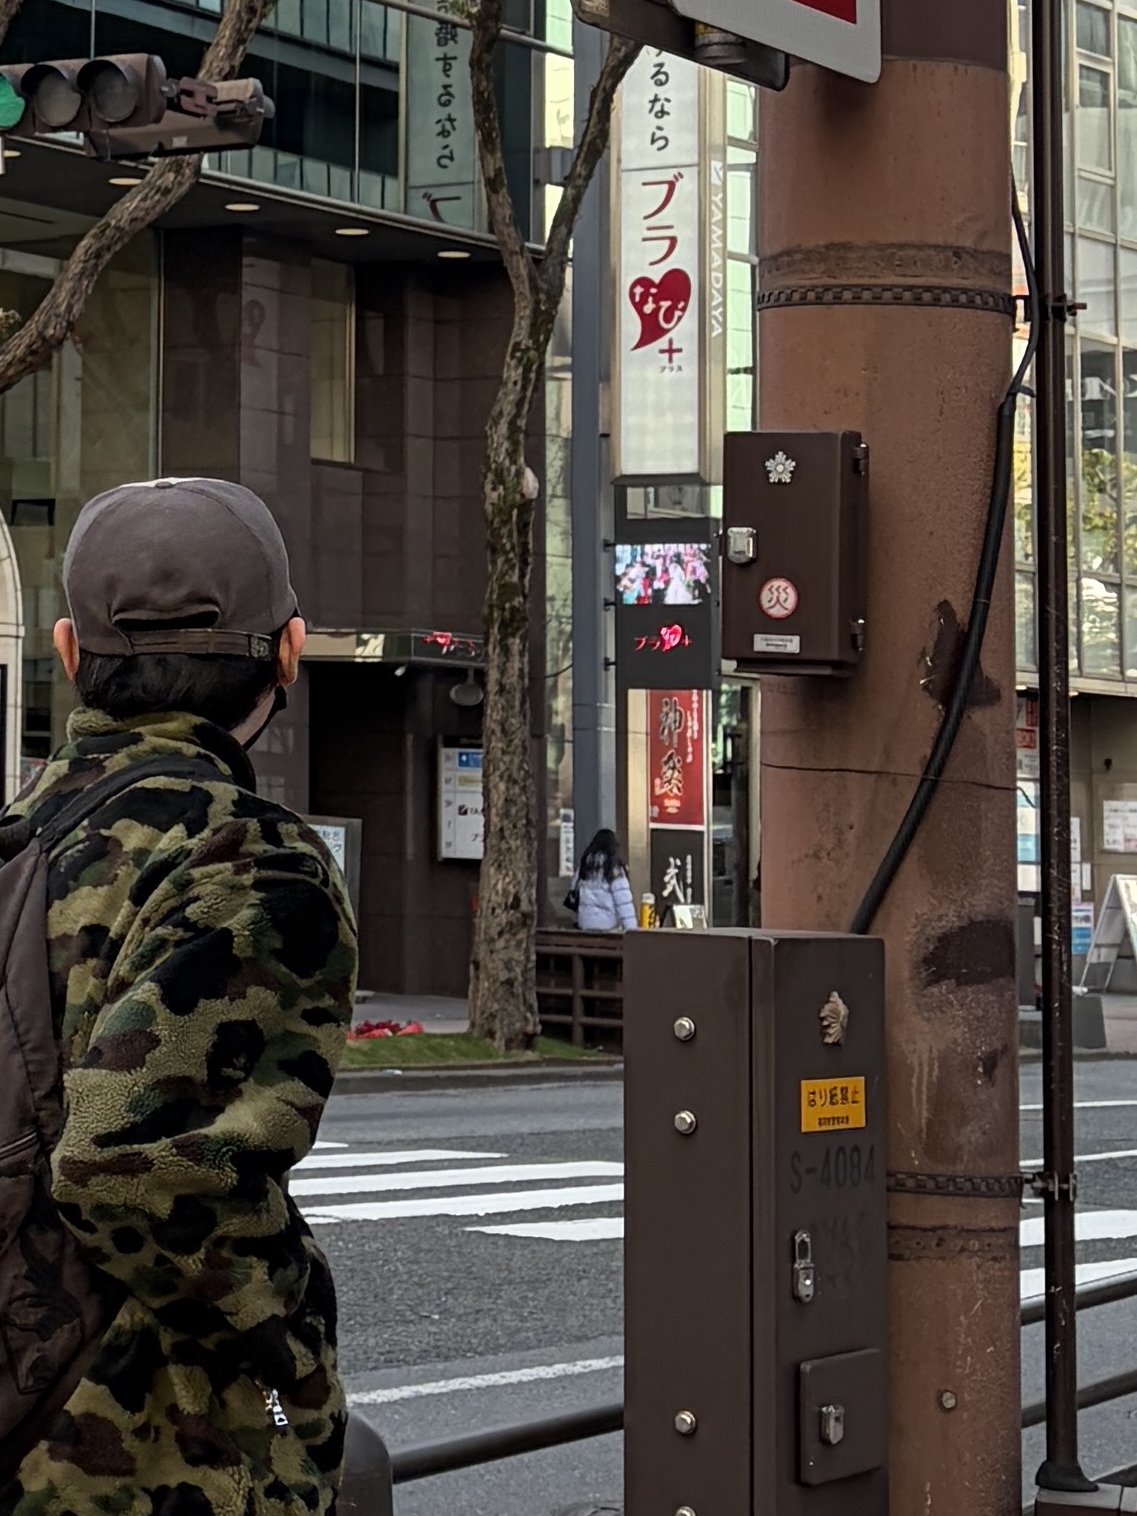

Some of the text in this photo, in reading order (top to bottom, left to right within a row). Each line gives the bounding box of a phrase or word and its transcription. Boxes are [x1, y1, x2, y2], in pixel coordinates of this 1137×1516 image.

[647, 48, 672, 151] るなら
[711, 192, 723, 338] YAMADAYA
